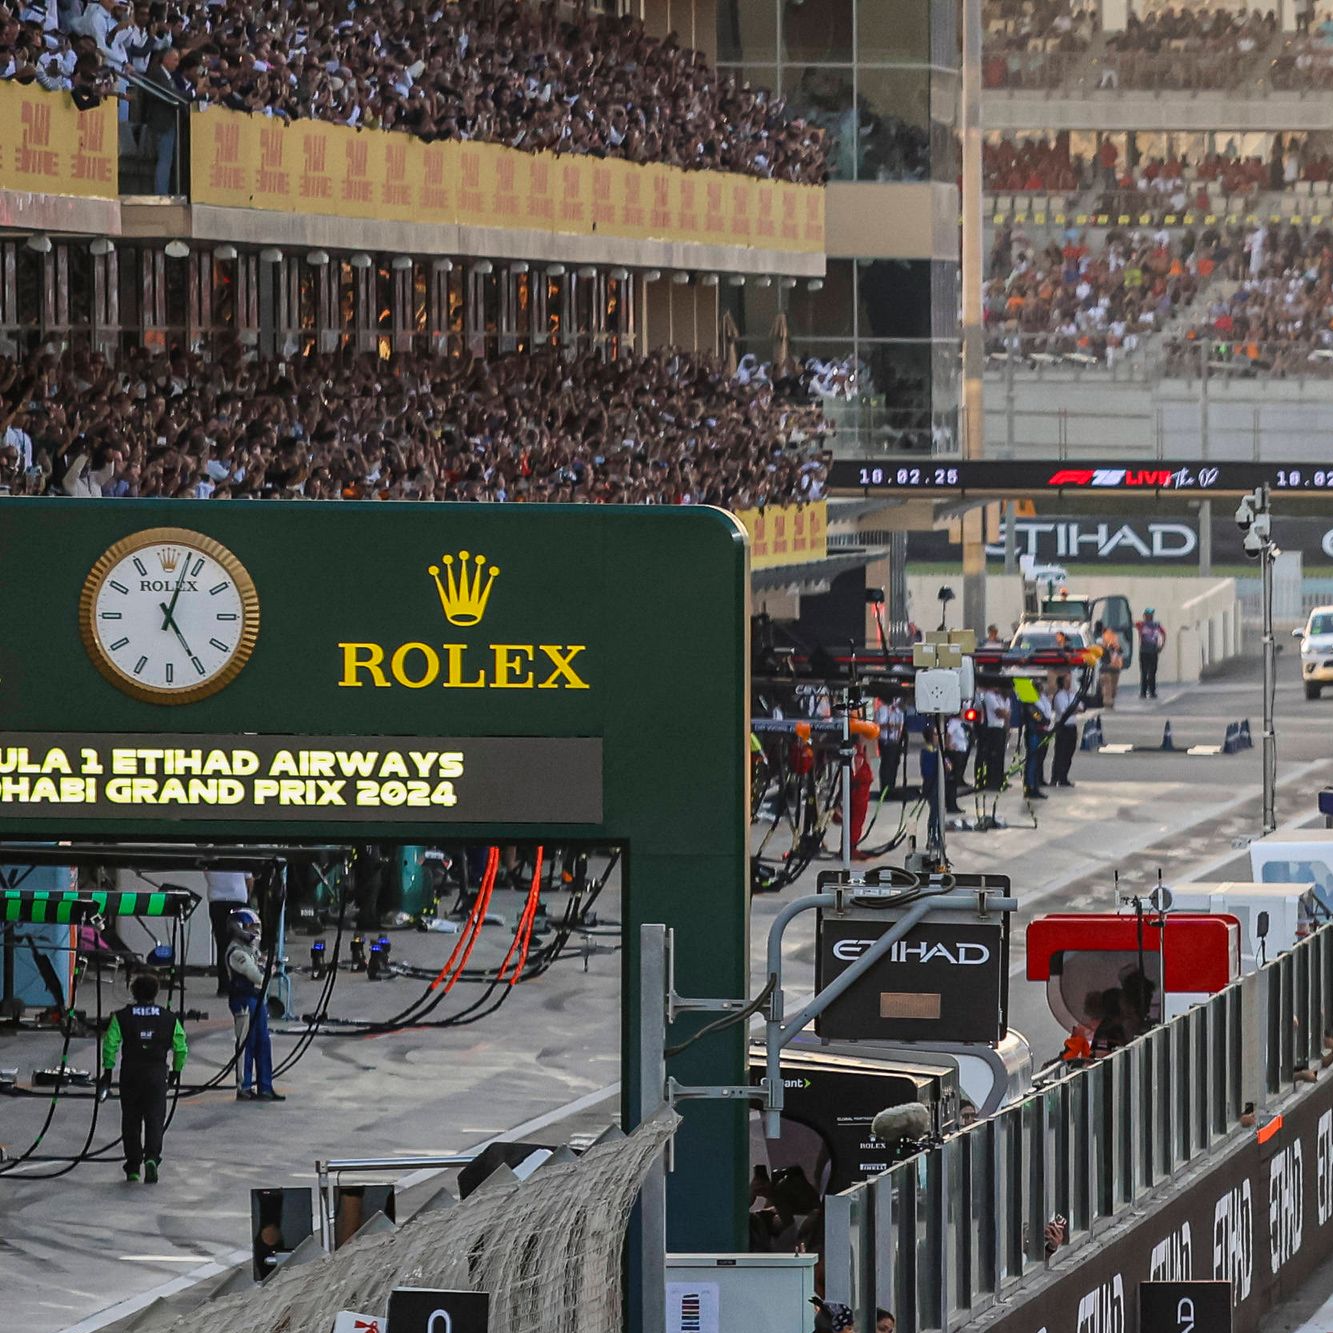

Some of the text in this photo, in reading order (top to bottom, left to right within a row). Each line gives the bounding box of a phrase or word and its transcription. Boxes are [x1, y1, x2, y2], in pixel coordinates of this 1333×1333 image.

[139, 580, 199, 592] ROLEX
[338, 642, 590, 690] ROLEX
[81, 748, 102, 774] 1
[112, 748, 260, 776] ETIHAD
[268, 750, 464, 778] AIRWAYS
[0, 776, 457, 807] HABI GRAND PRIX 2024
